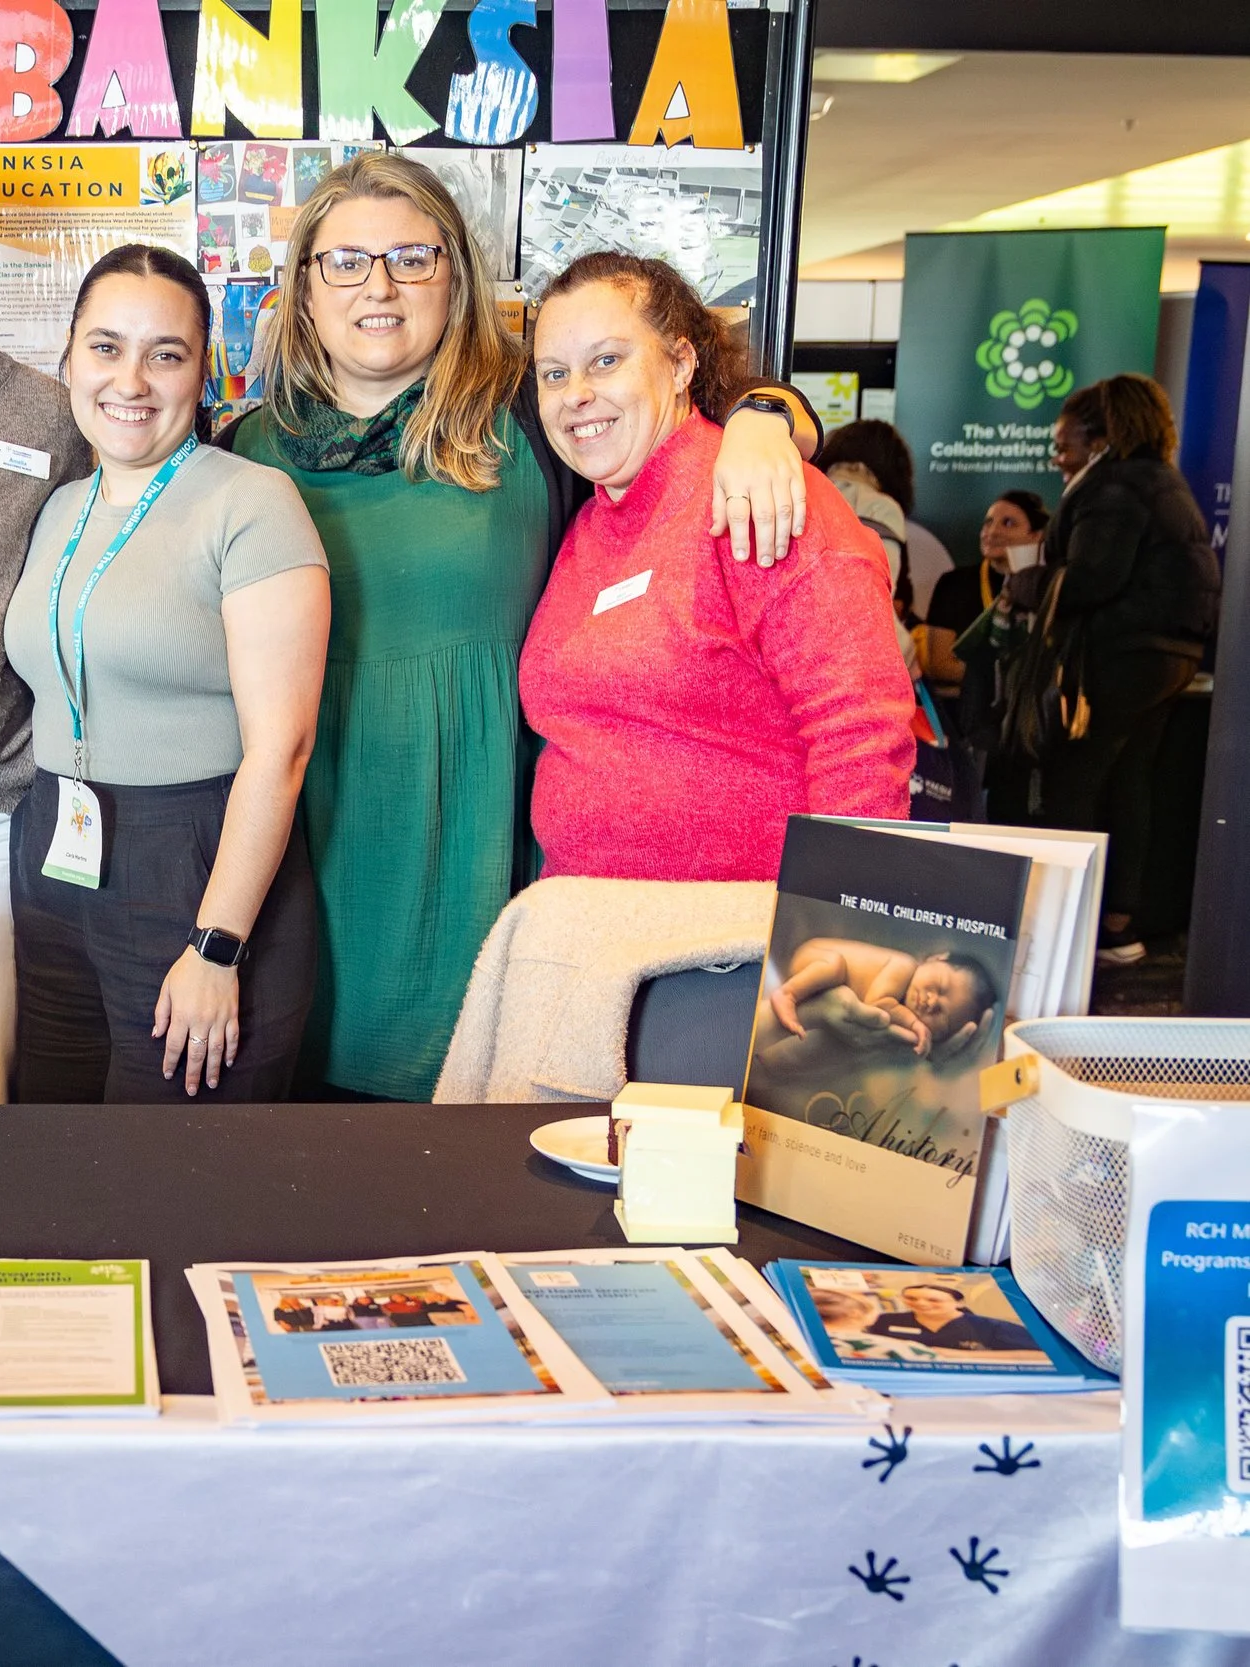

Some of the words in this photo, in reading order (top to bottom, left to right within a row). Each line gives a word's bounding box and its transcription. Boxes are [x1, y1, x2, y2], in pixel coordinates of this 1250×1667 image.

[962, 423, 995, 439] The
[997, 423, 1056, 439] Victori
[170, 437, 196, 468] Collab
[930, 441, 1046, 457] Collaborative
[143, 479, 164, 500] The
[69, 521, 84, 542] The
[121, 502, 148, 536] Collab
[96, 550, 116, 572] The
[77, 572, 100, 609] Collab
[839, 893, 859, 909] THE
[859, 897, 890, 916] ROYAL
[893, 904, 954, 929] CHILDREN'S
[956, 917, 1007, 940] HOSPITAL
[784, 1137, 821, 1158] science
[823, 1149, 842, 1166] and
[845, 1157, 866, 1174] love
[882, 1117, 978, 1189] history
[1185, 1222, 1227, 1239] RCH
[897, 1232, 926, 1251] PETER
[929, 1243, 952, 1260] YULE
[1161, 1250, 1250, 1273] Programs
